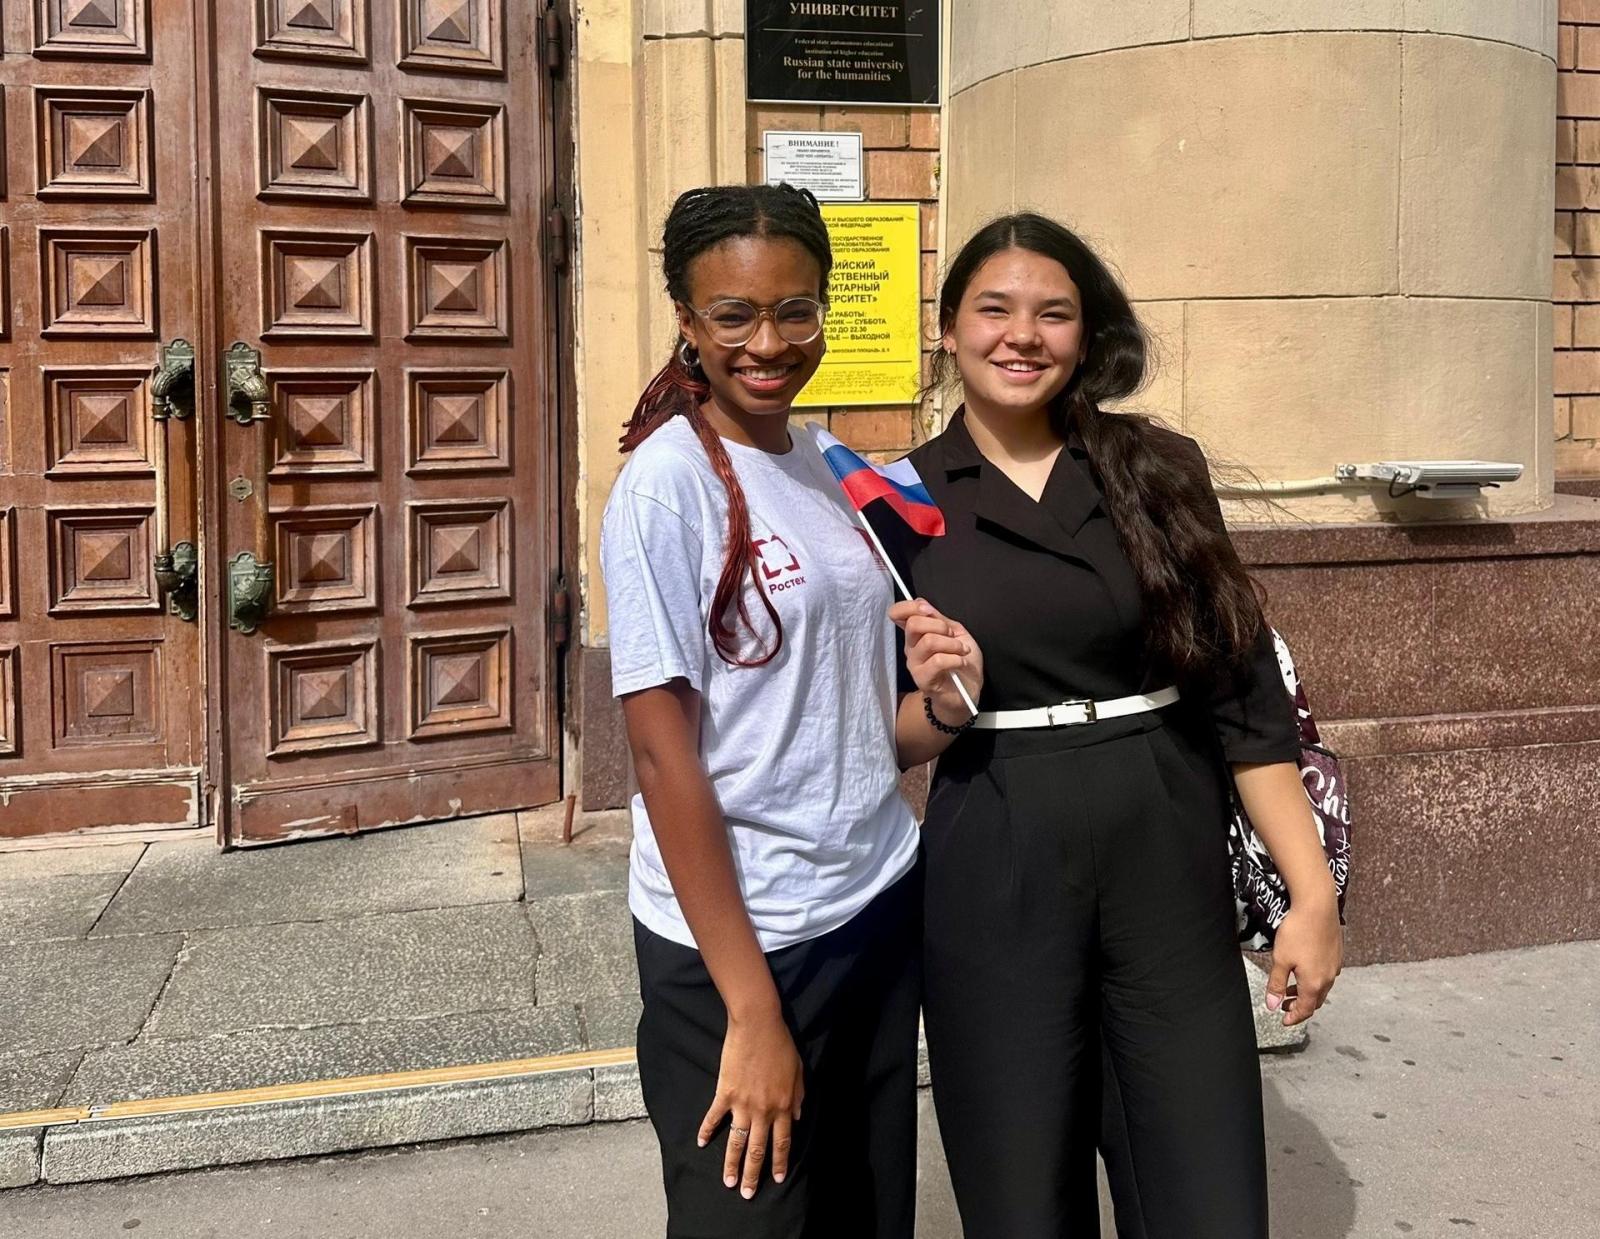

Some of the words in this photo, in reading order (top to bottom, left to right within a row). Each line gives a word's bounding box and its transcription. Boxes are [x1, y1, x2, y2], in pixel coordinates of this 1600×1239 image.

[790, 2, 899, 18] УНИВЕРСИТЕТ
[783, 56, 824, 68] Russian
[827, 59, 852, 69] state
[854, 59, 905, 72] university
[797, 68, 814, 79] for
[815, 69, 832, 80] the
[834, 70, 891, 81] humanities
[832, 259, 876, 270] ИЙСКИЙ
[827, 270, 889, 281] РСТВЕННЫЙ
[828, 294, 878, 303] ЕРСИТЕТ»
[850, 333, 890, 341] ВЫХОДНОЙ
